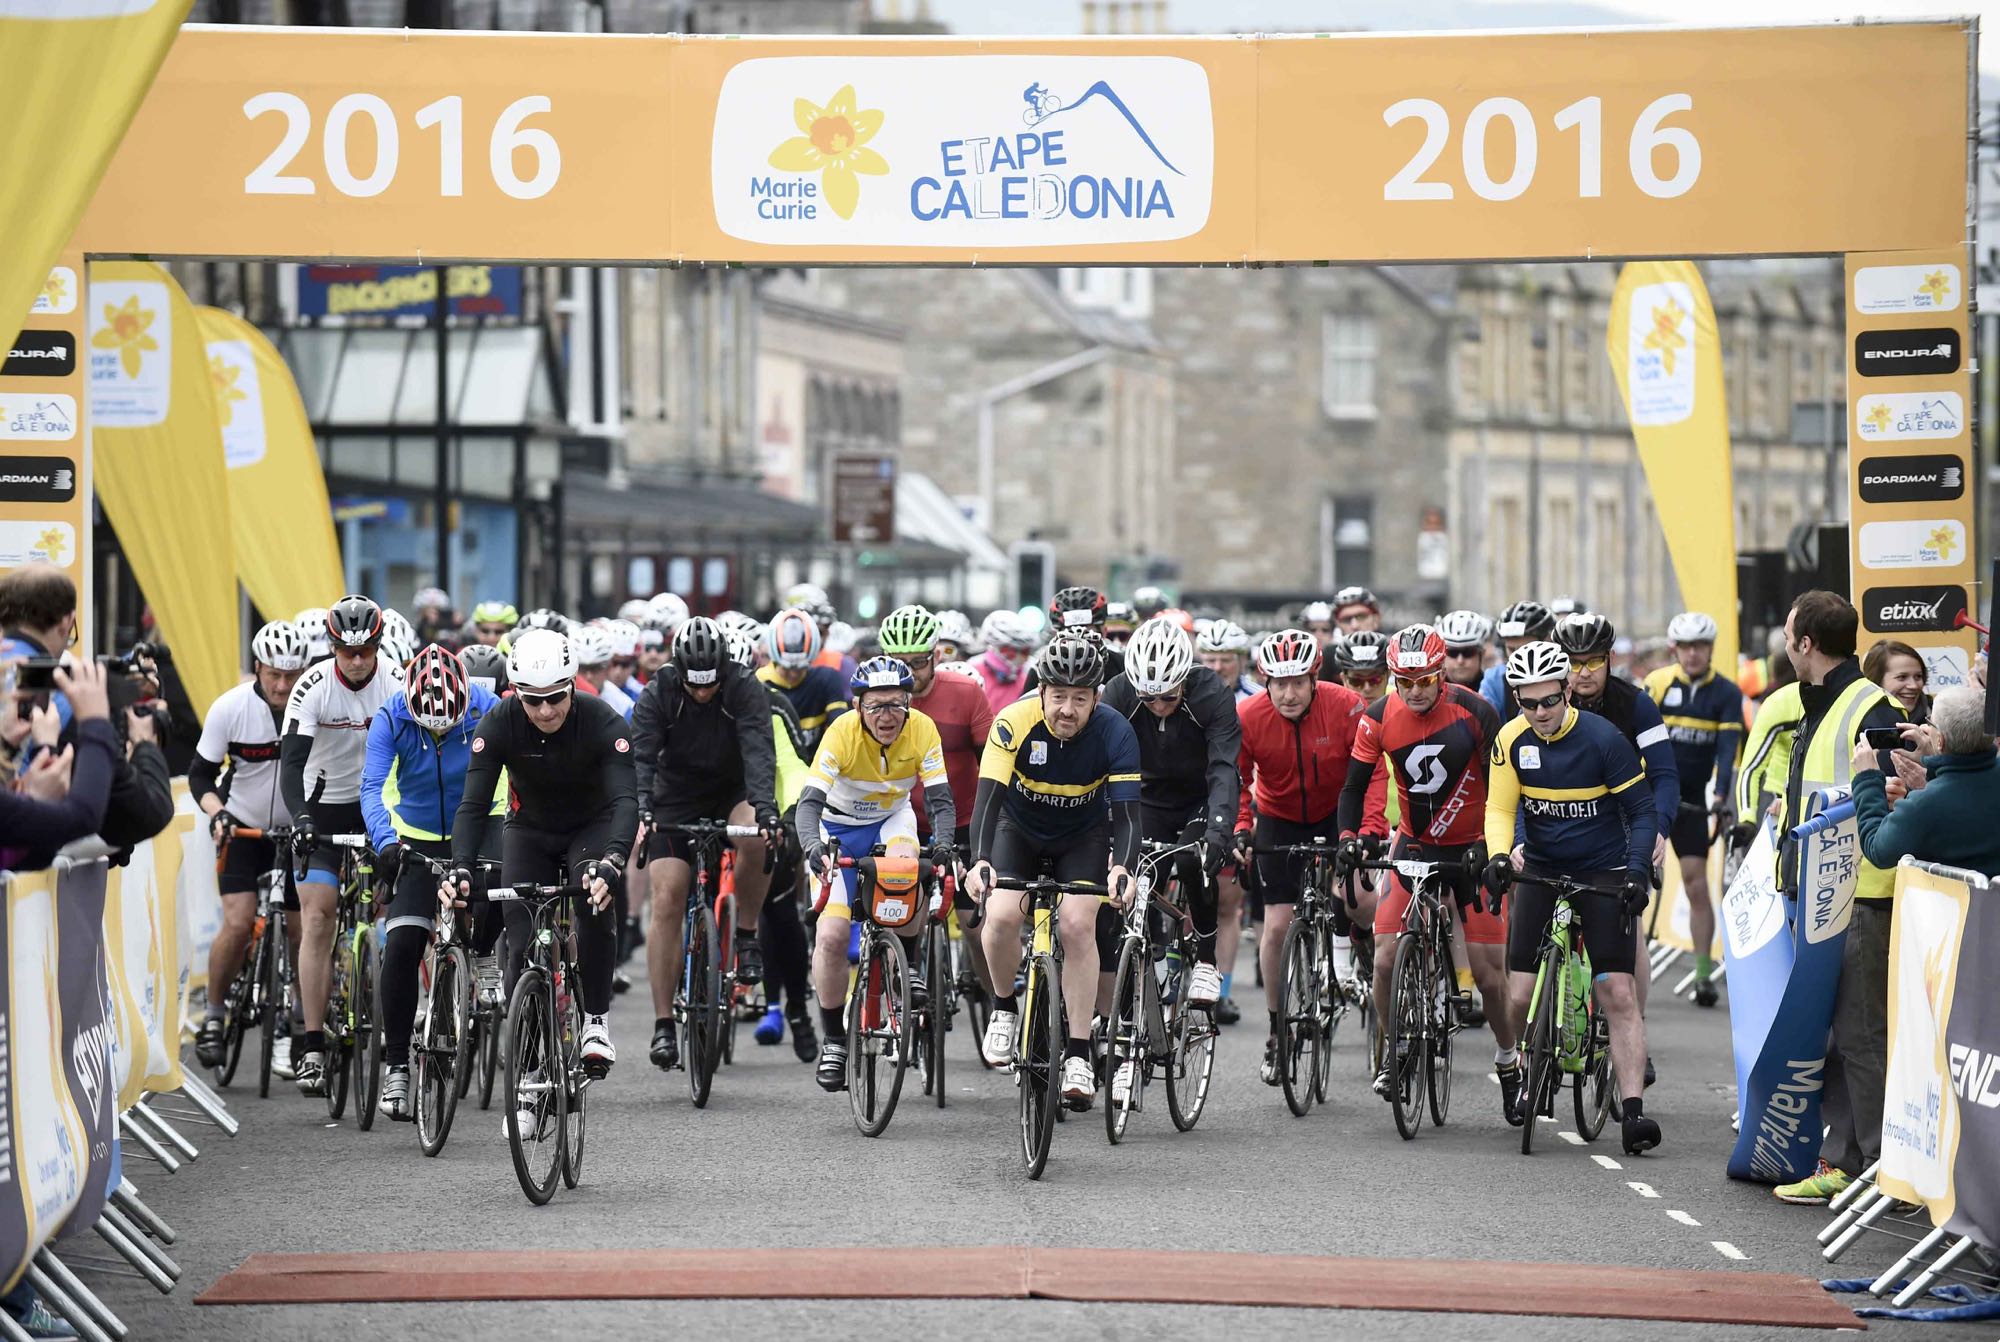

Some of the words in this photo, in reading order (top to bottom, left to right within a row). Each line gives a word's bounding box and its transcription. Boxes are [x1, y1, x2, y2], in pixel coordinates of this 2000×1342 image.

[243, 92, 561, 200] 2016
[1383, 93, 1702, 201] 2016
[941, 131, 1067, 177] ETAPE
[750, 177, 817, 198] Marie
[910, 174, 1175, 222] CALEDONIA
[757, 199, 817, 220] Curie
[8, 349, 58, 358] DURA
[1864, 348, 1942, 359] ENDURA
[17, 412, 46, 422] EAPE
[1903, 410, 1933, 423] EAPE
[10, 421, 70, 433] CAEONIA
[1897, 420, 1957, 433] CAEONIA
[1863, 473, 1937, 485] BOARDMAN
[350, 635, 363, 645] 88
[532, 659, 547, 670] 47
[1402, 656, 1422, 666] 213
[875, 675, 895, 684] 100
[1143, 683, 1162, 694] 154
[427, 718, 448, 728] 124
[1429, 769, 1476, 838] SCOTT
[1837, 833, 1855, 884] ETAPE
[1402, 864, 1423, 875] 213
[1740, 864, 1760, 906] EAPE
[883, 907, 902, 917] 100
[1760, 1057, 1826, 1149] Marie
